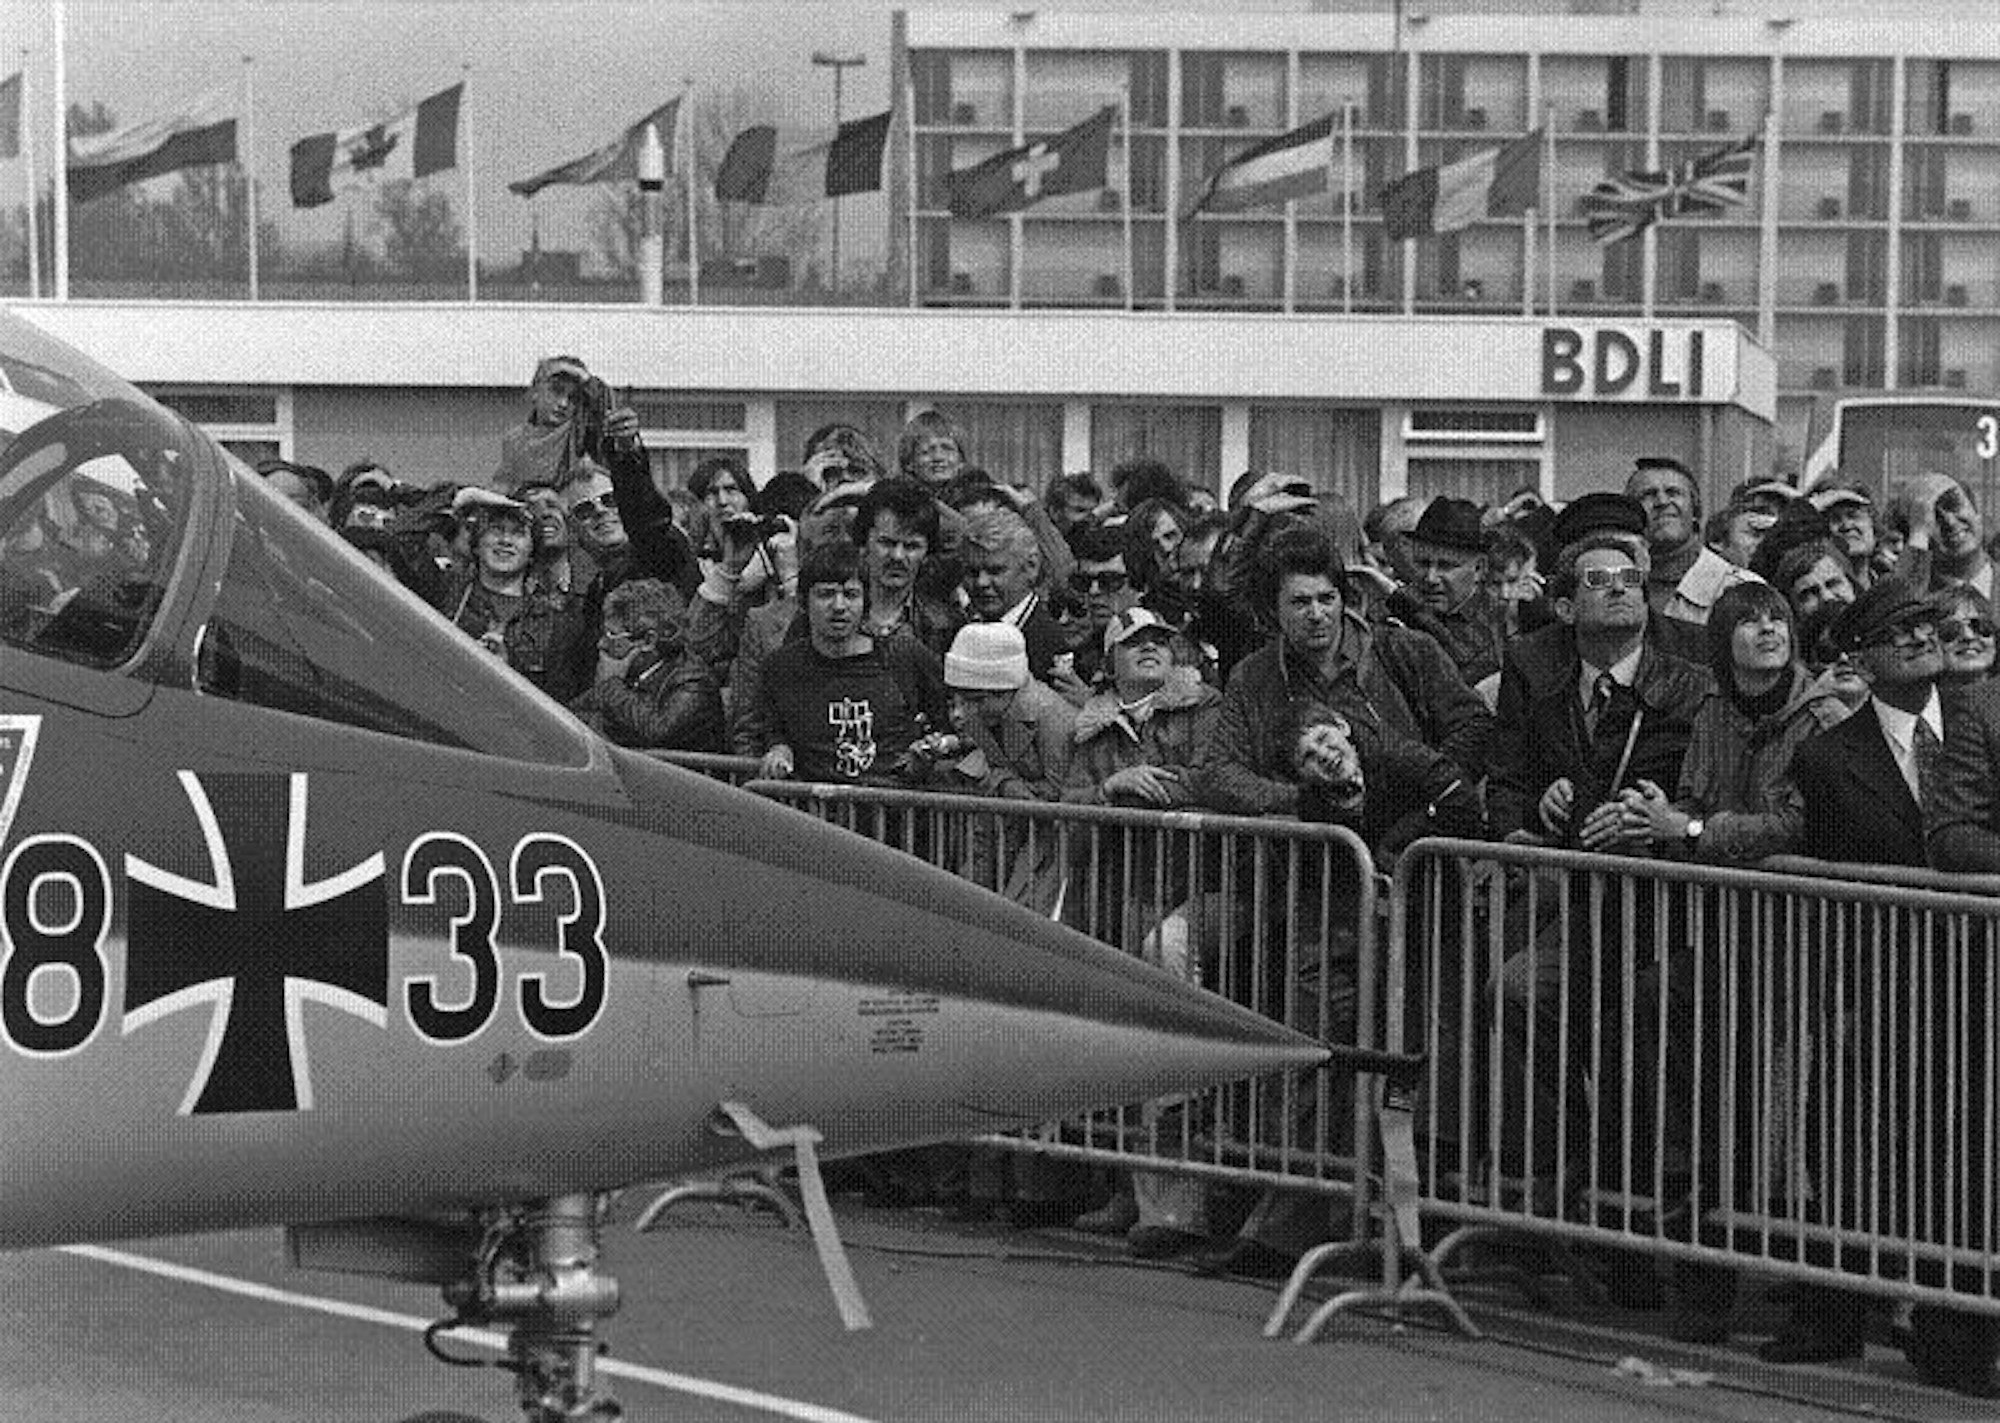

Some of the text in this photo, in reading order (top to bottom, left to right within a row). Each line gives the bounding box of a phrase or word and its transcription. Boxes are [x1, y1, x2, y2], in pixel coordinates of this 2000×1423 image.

[1542, 328, 1703, 396] BDLI
[1976, 414, 1998, 459] 3
[0, 831, 611, 1058] 8 33
